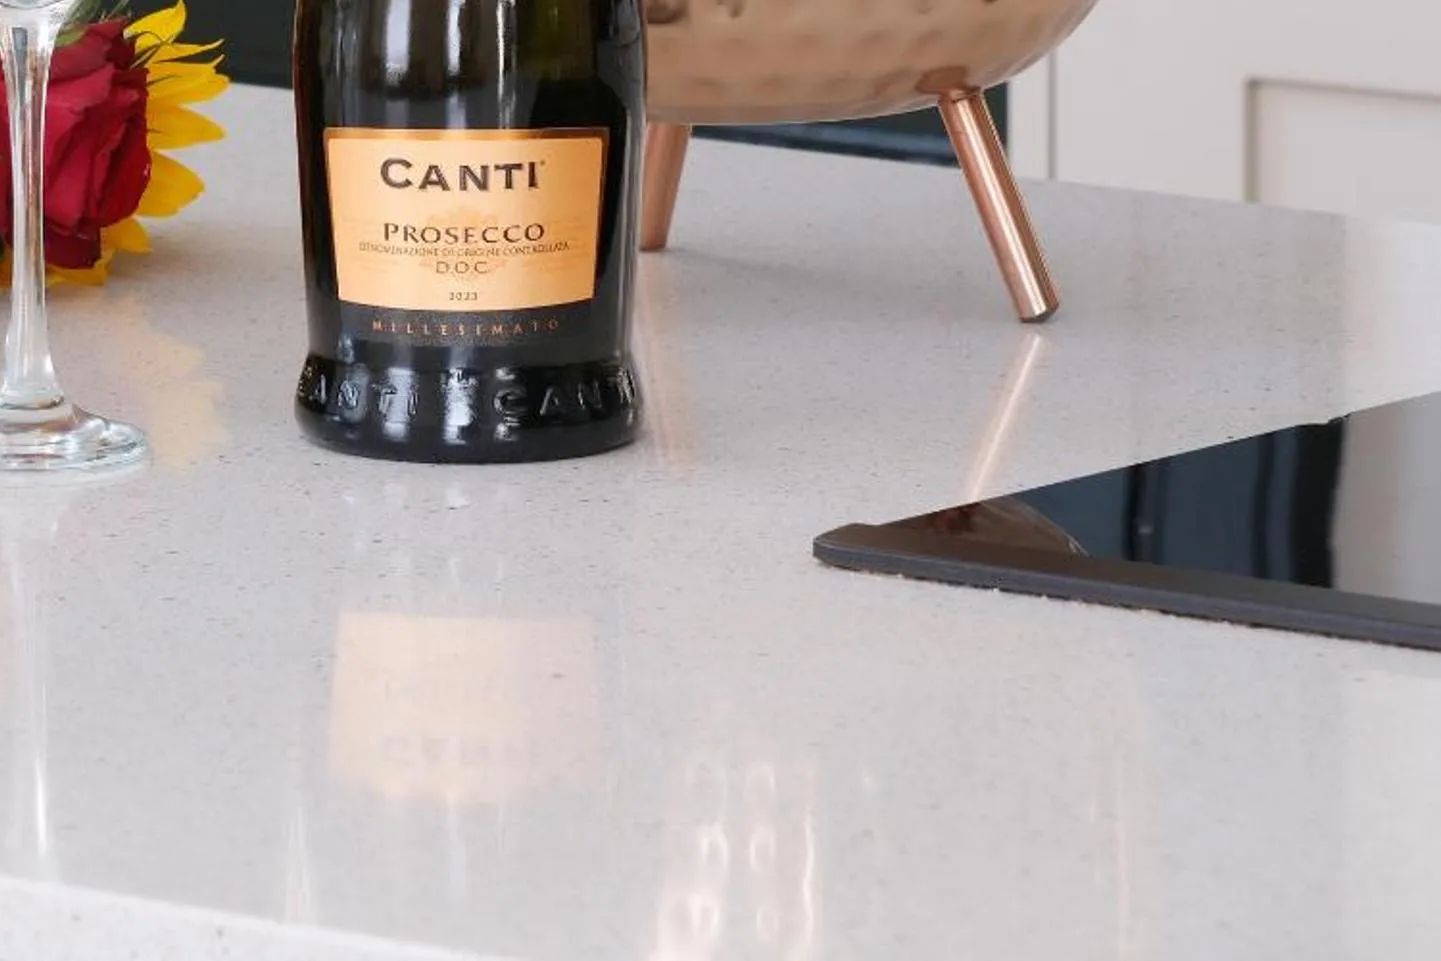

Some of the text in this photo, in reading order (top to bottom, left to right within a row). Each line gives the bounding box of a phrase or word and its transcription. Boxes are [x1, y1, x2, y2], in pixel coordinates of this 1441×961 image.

[379, 157, 540, 191] CANTI
[383, 222, 546, 245] PROSECCO
[371, 316, 560, 337] MILLESIMATO
